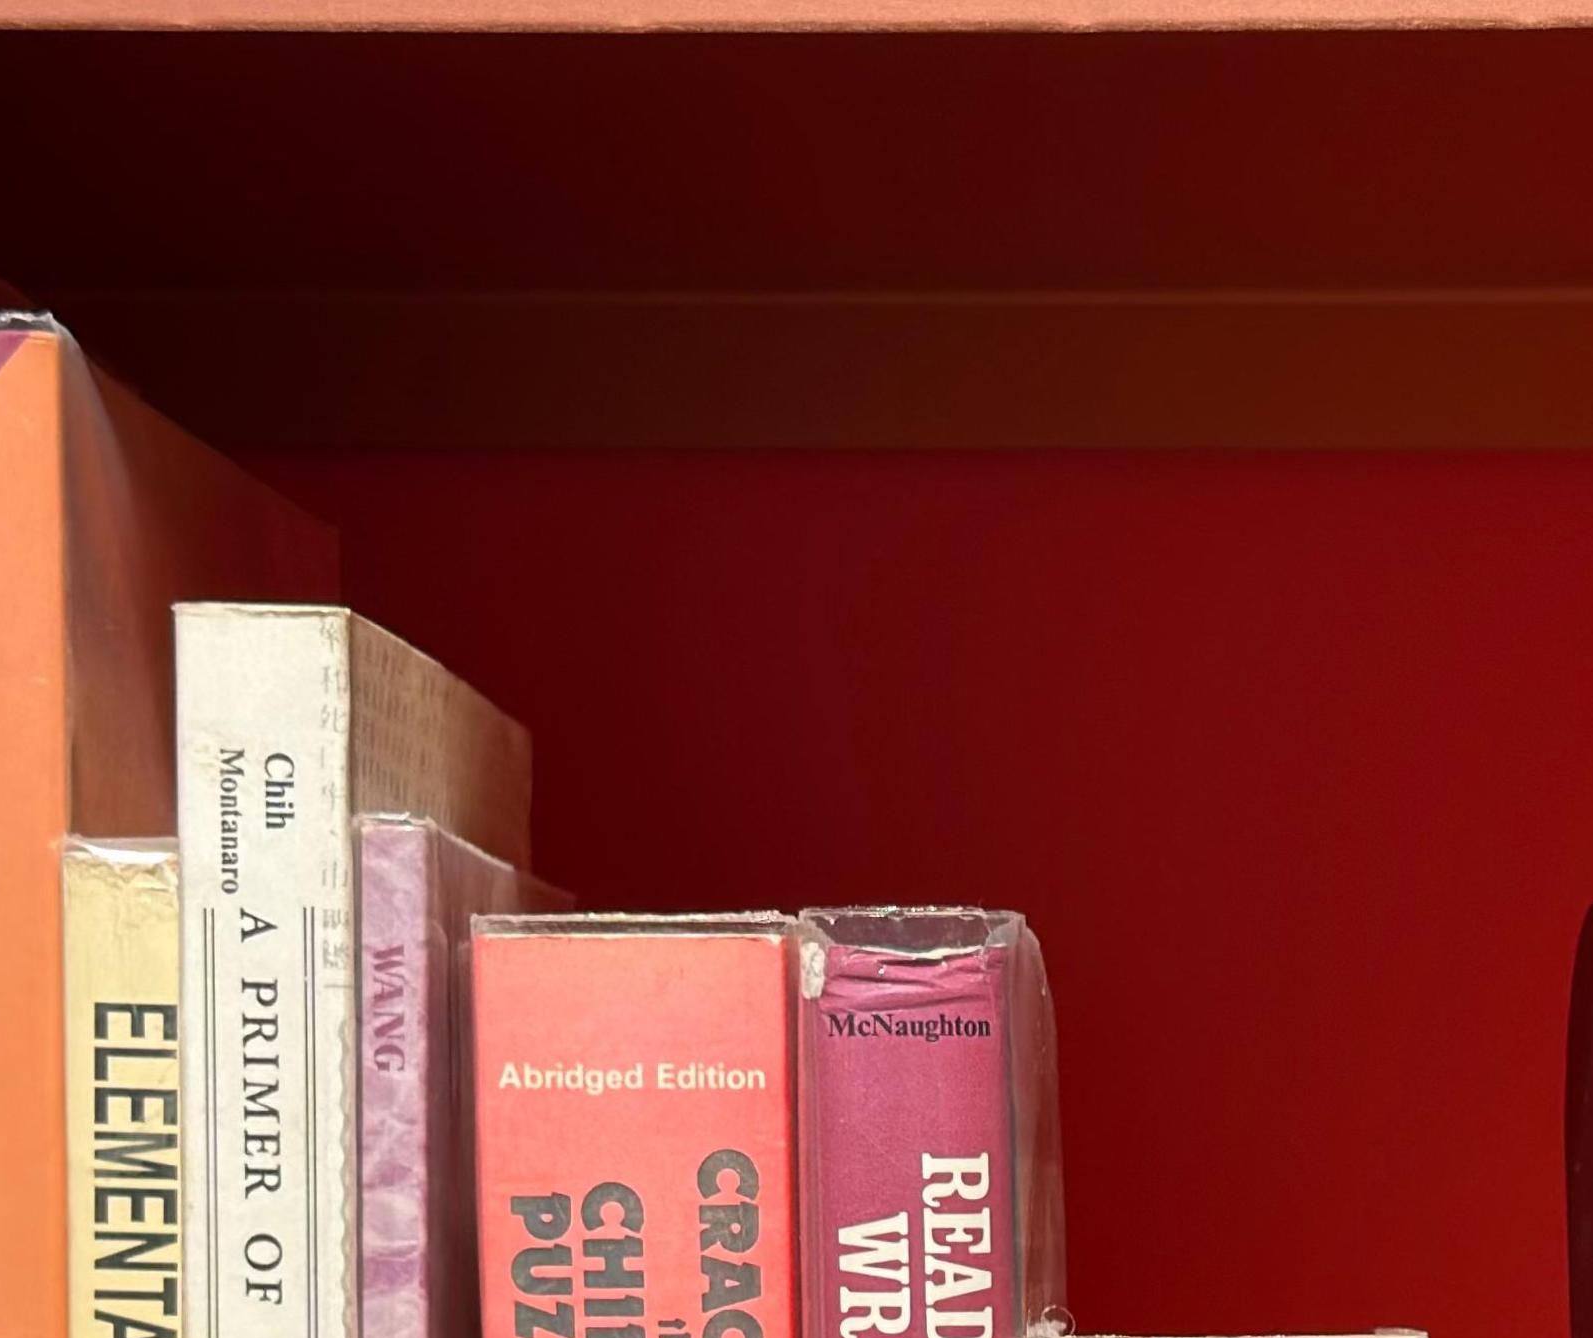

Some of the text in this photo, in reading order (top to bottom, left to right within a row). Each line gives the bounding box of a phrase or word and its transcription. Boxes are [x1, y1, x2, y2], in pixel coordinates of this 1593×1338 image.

[219, 748, 246, 895] Montanaro
[264, 751, 295, 830] Chih
[240, 907, 278, 943] A
[372, 944, 406, 1074] WANG
[828, 1013, 991, 1042] McNaughton
[241, 977, 282, 1199] PRIMER
[499, 1063, 767, 1096] Abridged Edition
[243, 1234, 284, 1307] OF
